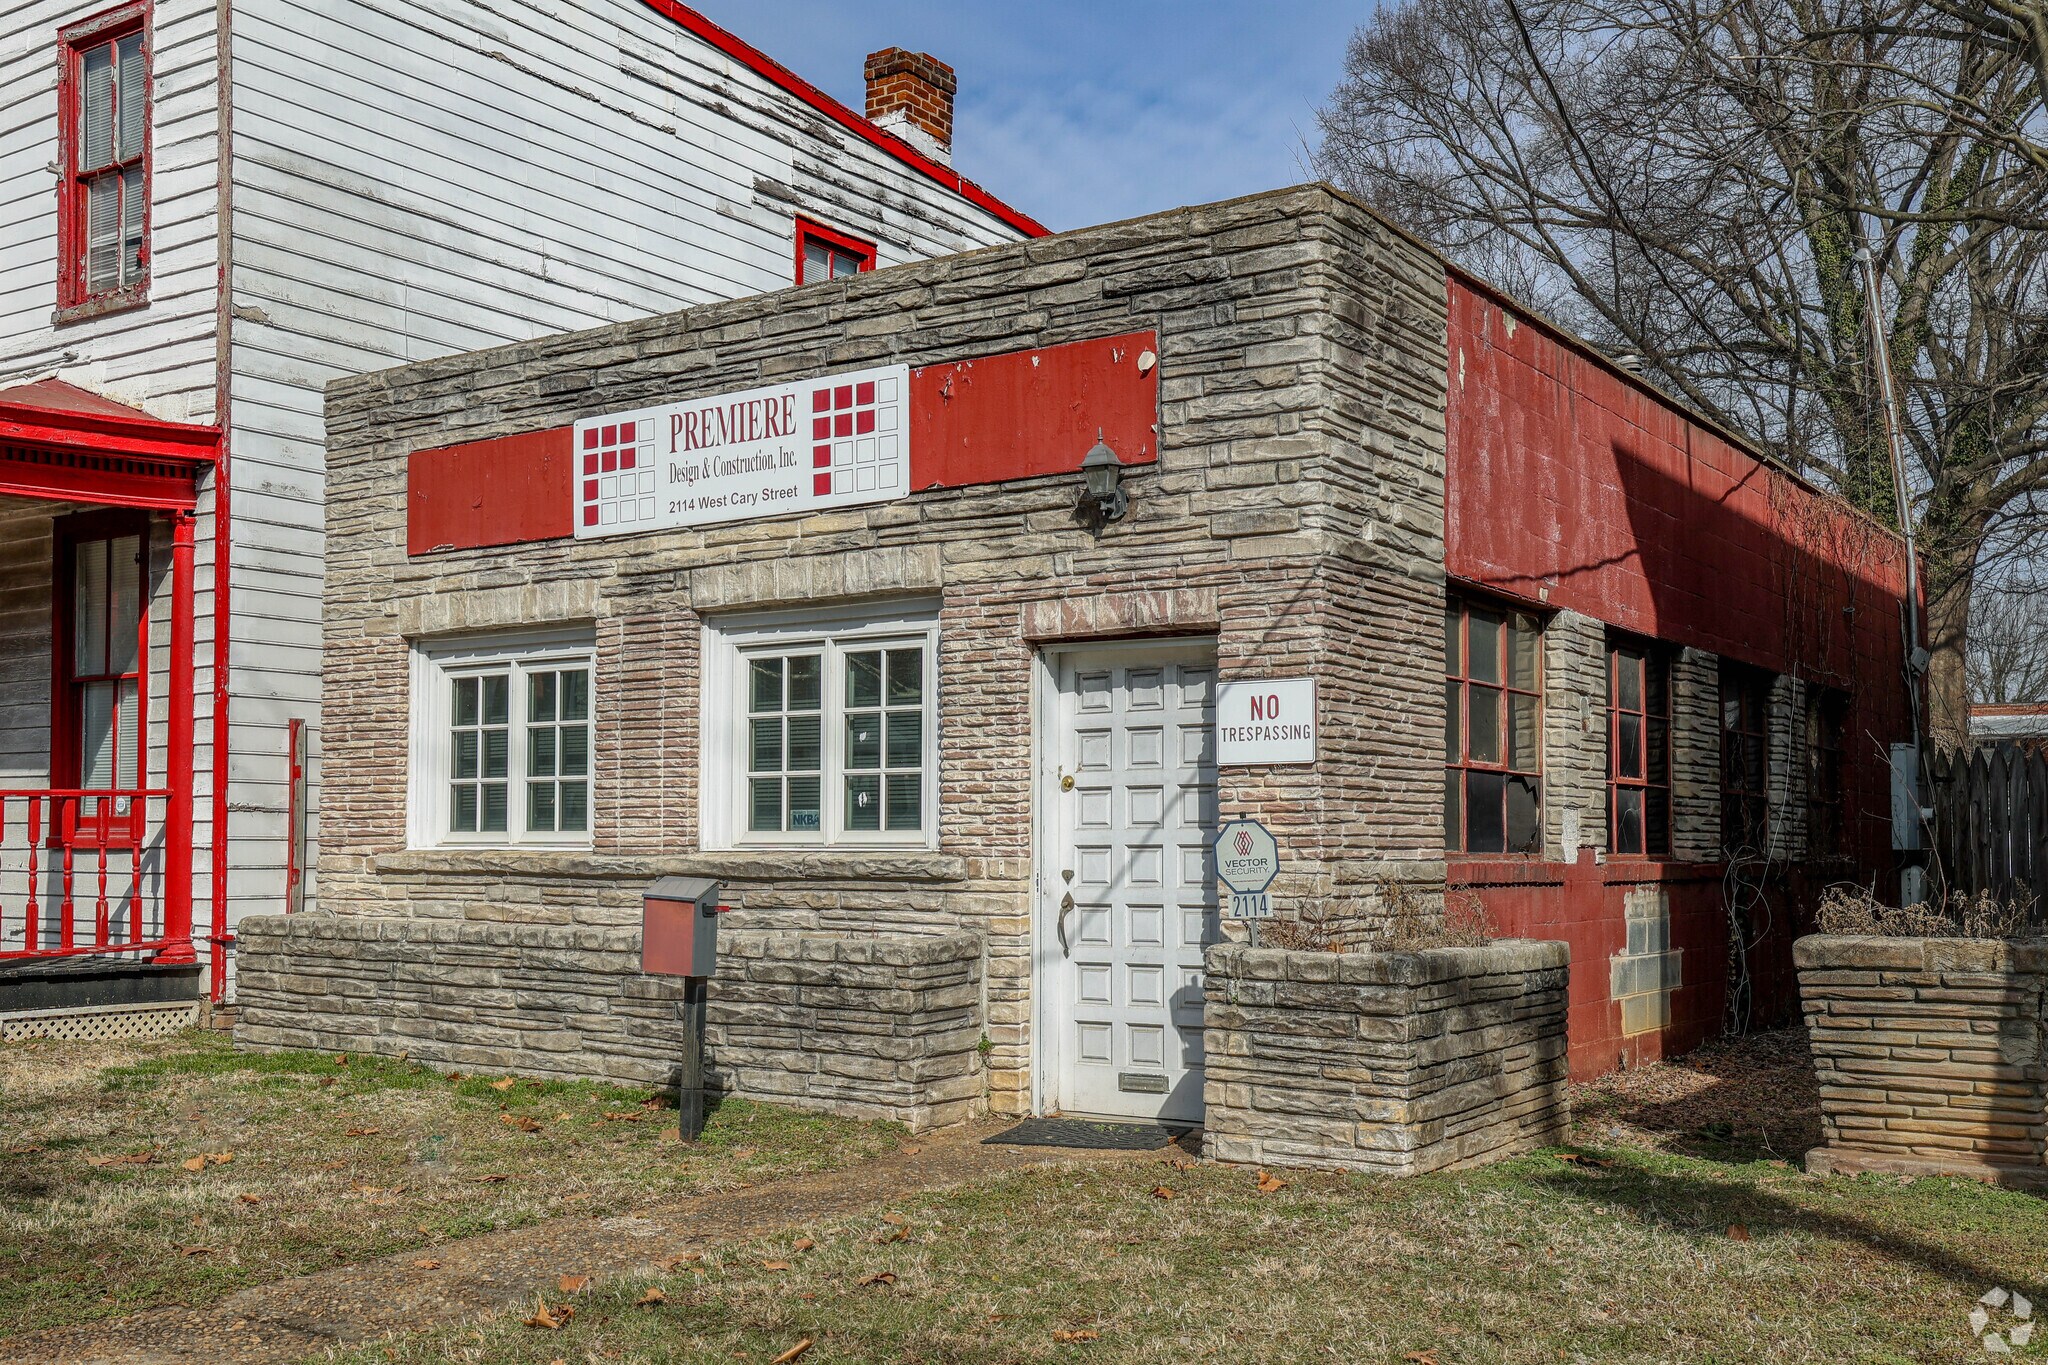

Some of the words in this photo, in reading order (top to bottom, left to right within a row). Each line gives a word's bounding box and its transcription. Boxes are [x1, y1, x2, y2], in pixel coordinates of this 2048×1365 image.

[669, 394, 797, 453] PREMIERE
[669, 460, 700, 487] Design
[702, 457, 711, 479] &
[713, 449, 777, 477] Construction,
[779, 446, 797, 468] Inc.
[669, 498, 695, 513] 2114
[698, 495, 727, 509] West
[730, 492, 758, 506] Cary
[761, 485, 798, 501] Street
[1250, 694, 1280, 721] NO
[1221, 724, 1311, 742] TRESPASSING
[1225, 858, 1268, 868] VECTOR
[1233, 894, 1268, 917] 2114
